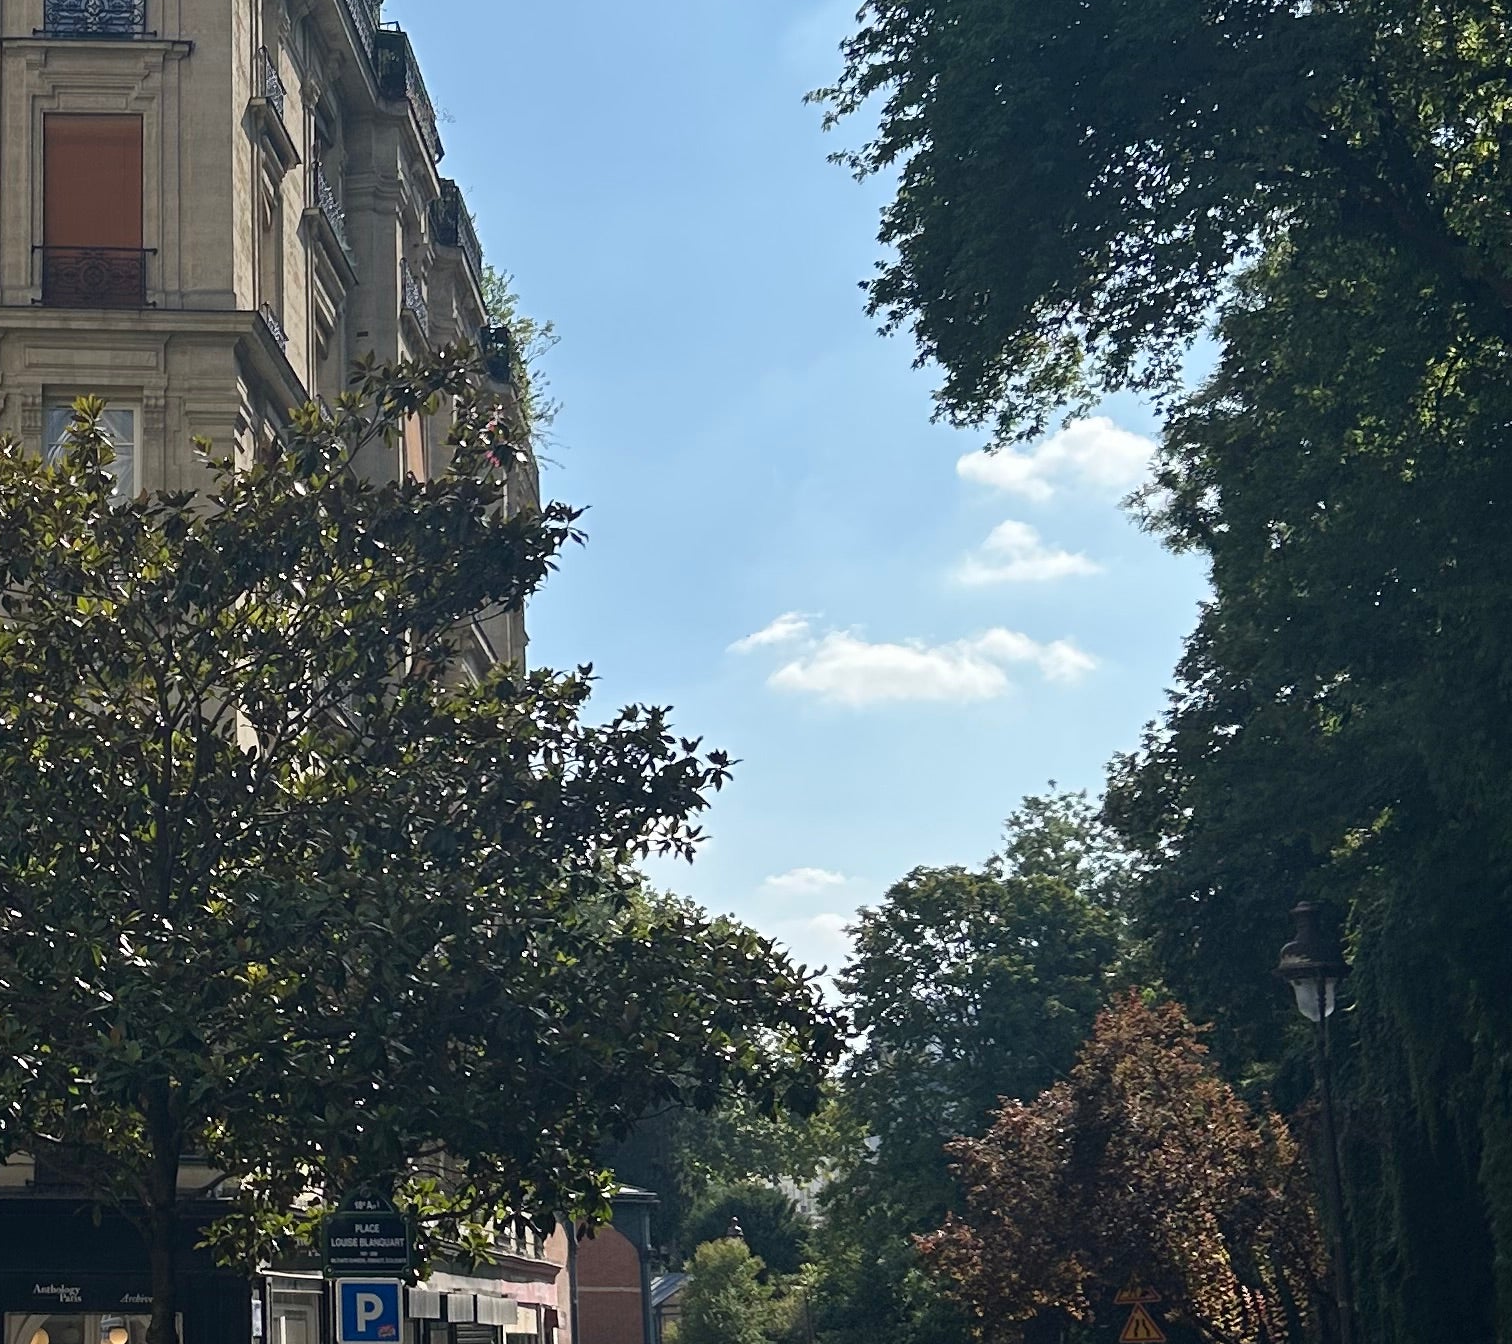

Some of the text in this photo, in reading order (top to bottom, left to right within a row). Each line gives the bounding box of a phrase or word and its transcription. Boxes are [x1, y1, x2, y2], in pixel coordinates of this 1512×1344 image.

[355, 1224, 380, 1233] PLACE
[331, 1238, 358, 1247] LOUISE
[359, 1238, 405, 1247] BLANQUART
[33, 1284, 81, 1295] Anthology
[59, 1293, 82, 1303] Paris
[356, 1293, 384, 1332] P
